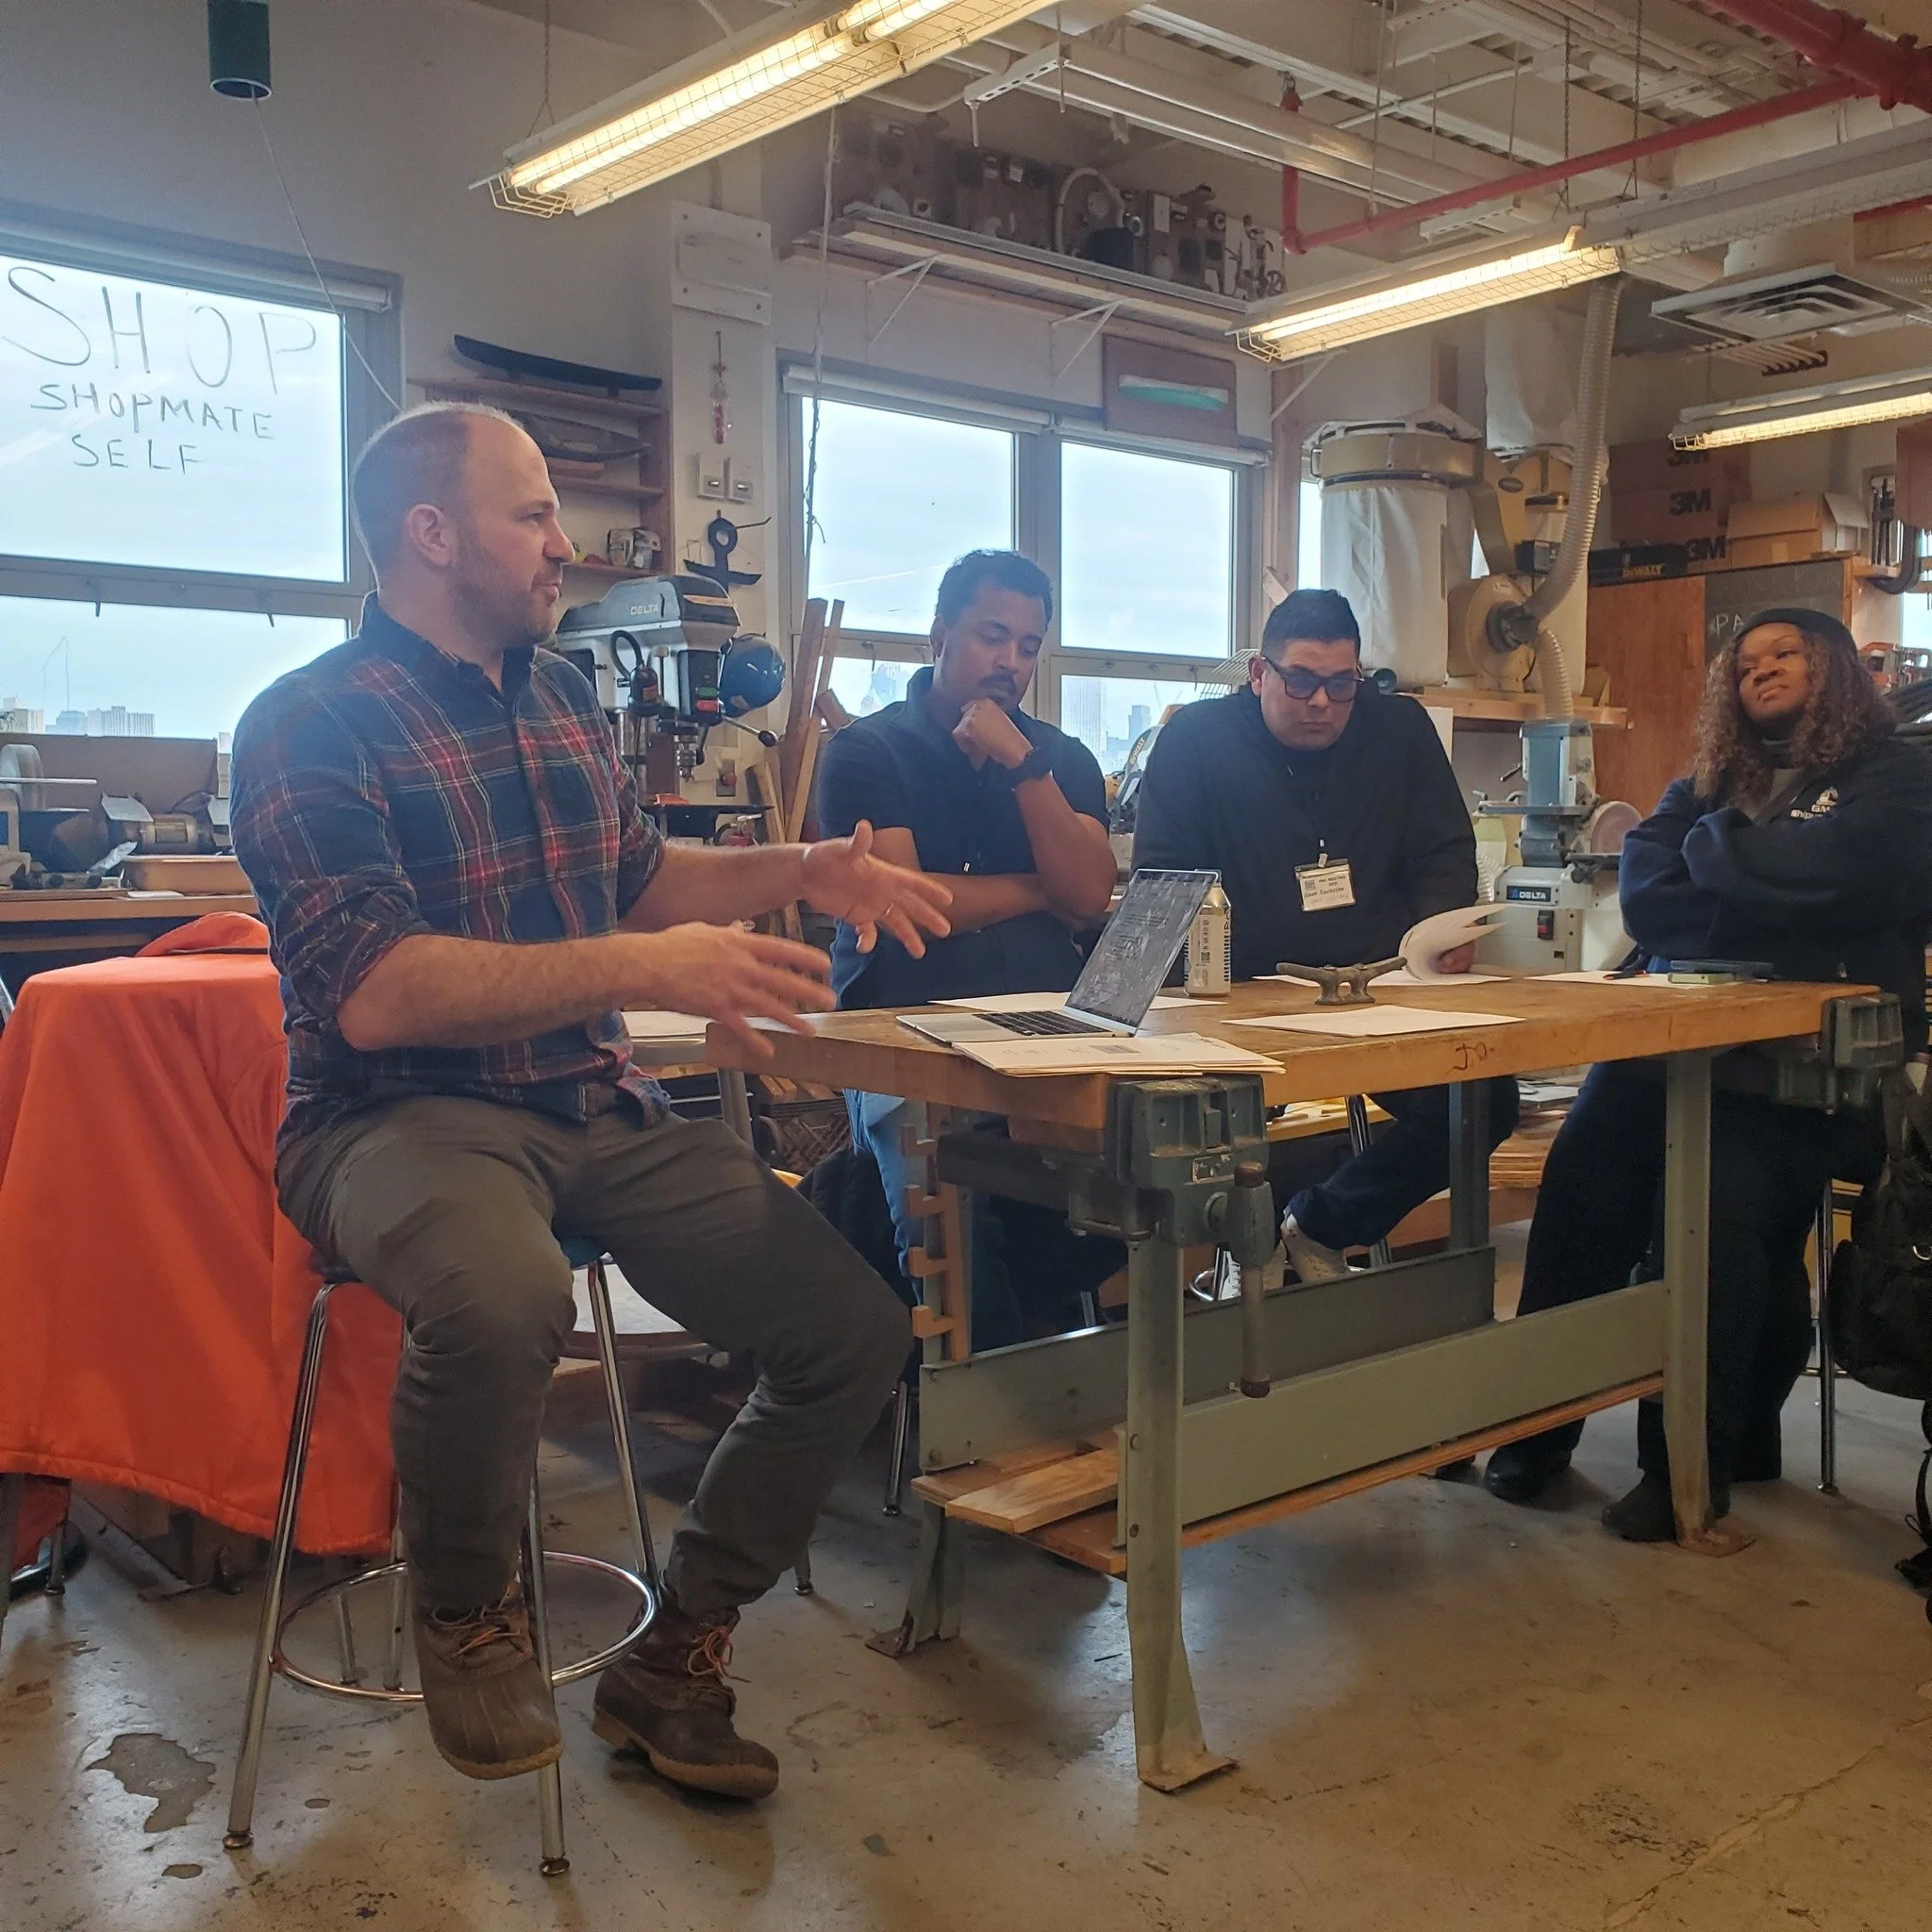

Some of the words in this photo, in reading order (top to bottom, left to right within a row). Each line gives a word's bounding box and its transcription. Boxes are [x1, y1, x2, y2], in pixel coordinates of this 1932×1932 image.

[2, 266, 317, 396] SHOP
[30, 382, 275, 441] SHOPMATE
[71, 434, 203, 474] SELF
[1670, 488, 1711, 516] 3M
[1687, 535, 1725, 562] 3M
[630, 604, 658, 615] DELTA
[1519, 891, 1547, 900] DELTA
